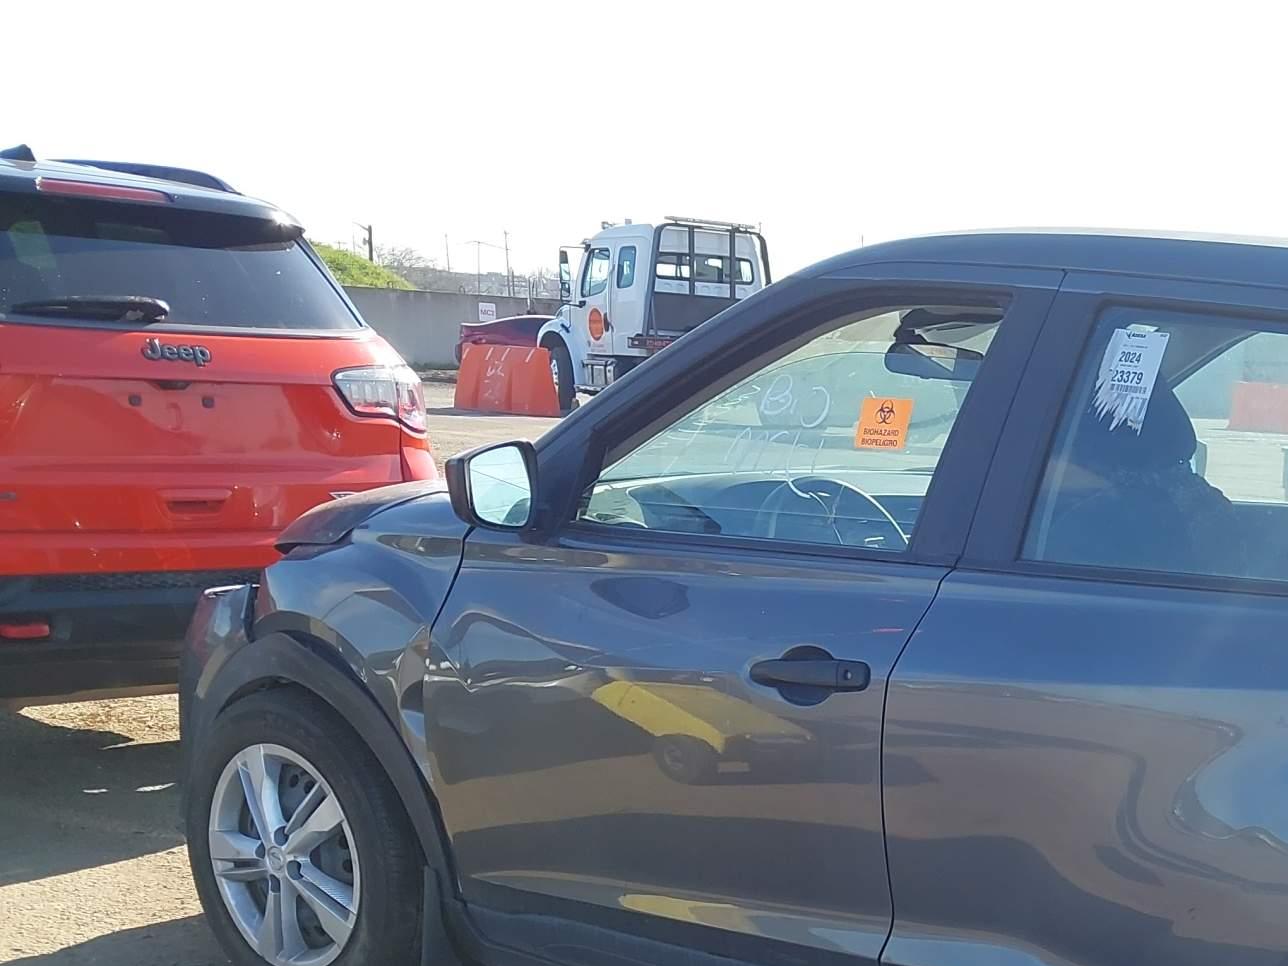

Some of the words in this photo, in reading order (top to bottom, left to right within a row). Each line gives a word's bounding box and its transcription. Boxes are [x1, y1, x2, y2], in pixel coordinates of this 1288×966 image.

[143, 337, 212, 367] Jeep
[1118, 350, 1142, 364] 2024
[863, 428, 900, 437] BIOHAZARD
[861, 438, 898, 447] BIOPELIGRO
